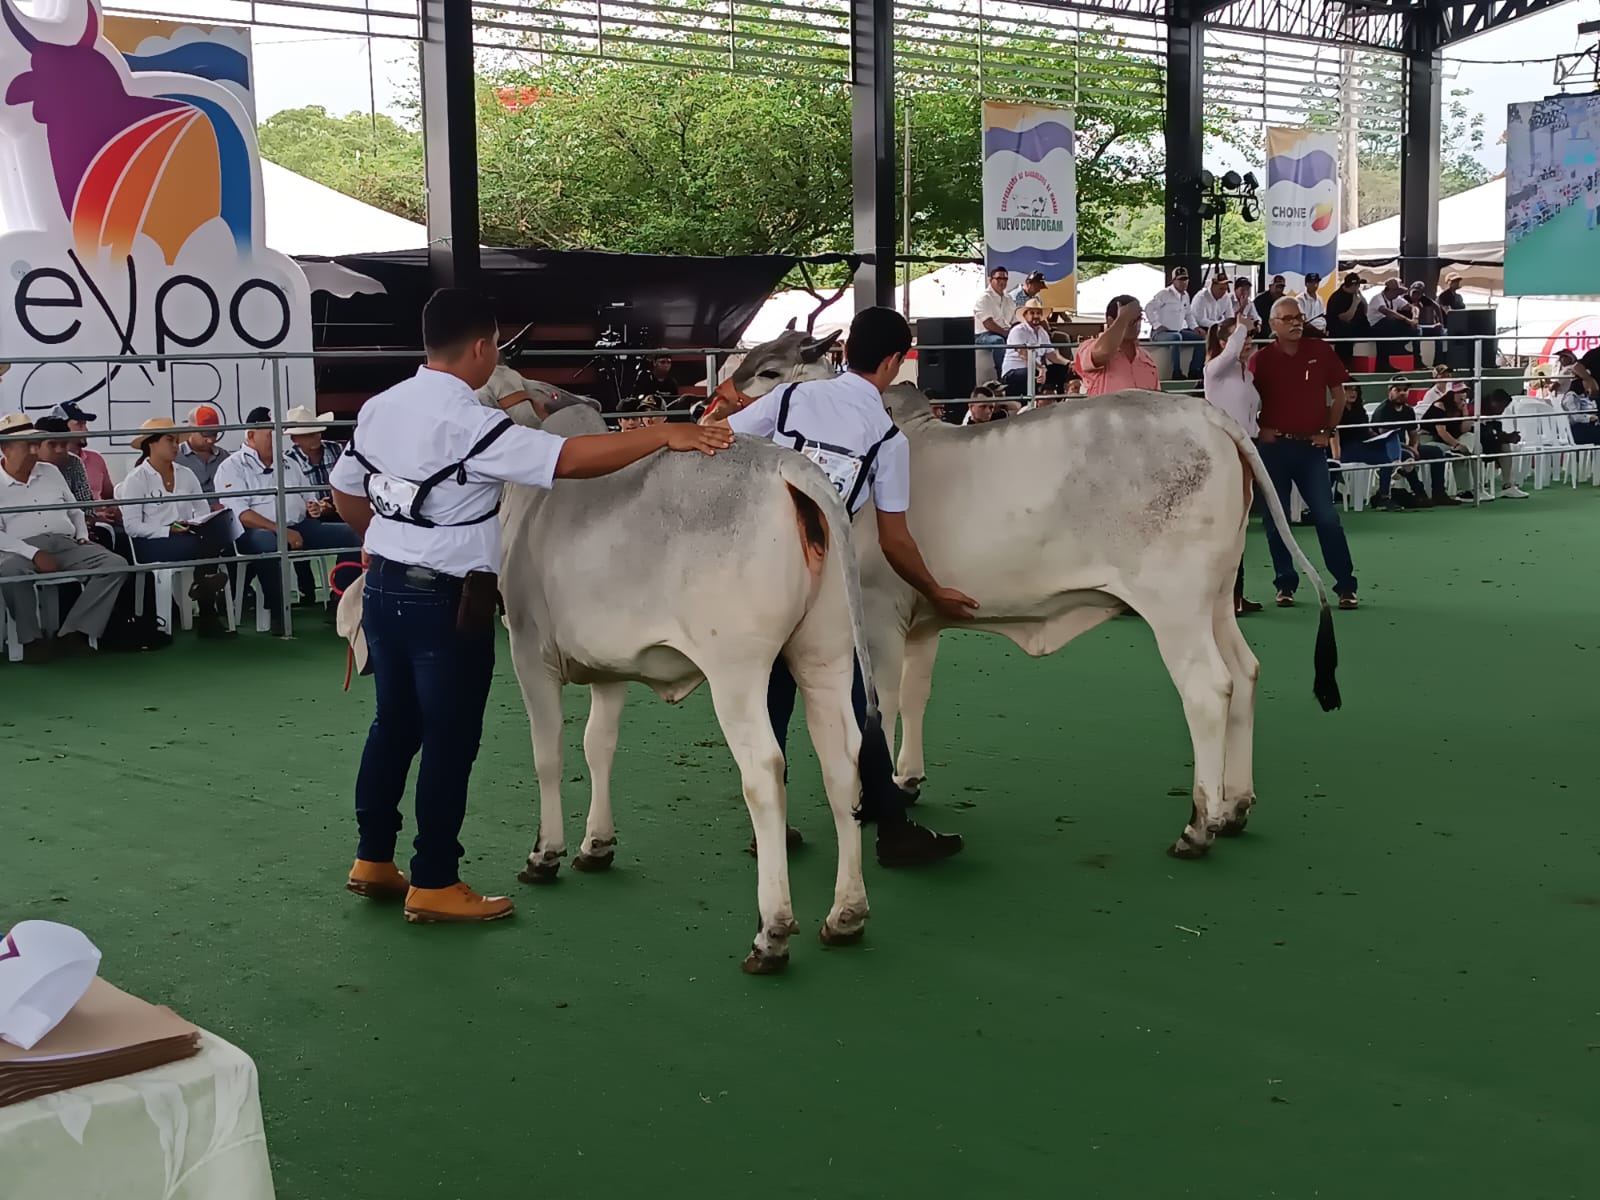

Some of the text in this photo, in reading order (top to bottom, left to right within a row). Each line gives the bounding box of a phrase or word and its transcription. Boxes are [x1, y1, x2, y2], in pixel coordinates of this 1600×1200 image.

[1271, 206, 1306, 218] CHONE
[997, 217, 1019, 231] NUEVO
[15, 249, 290, 395] expo
